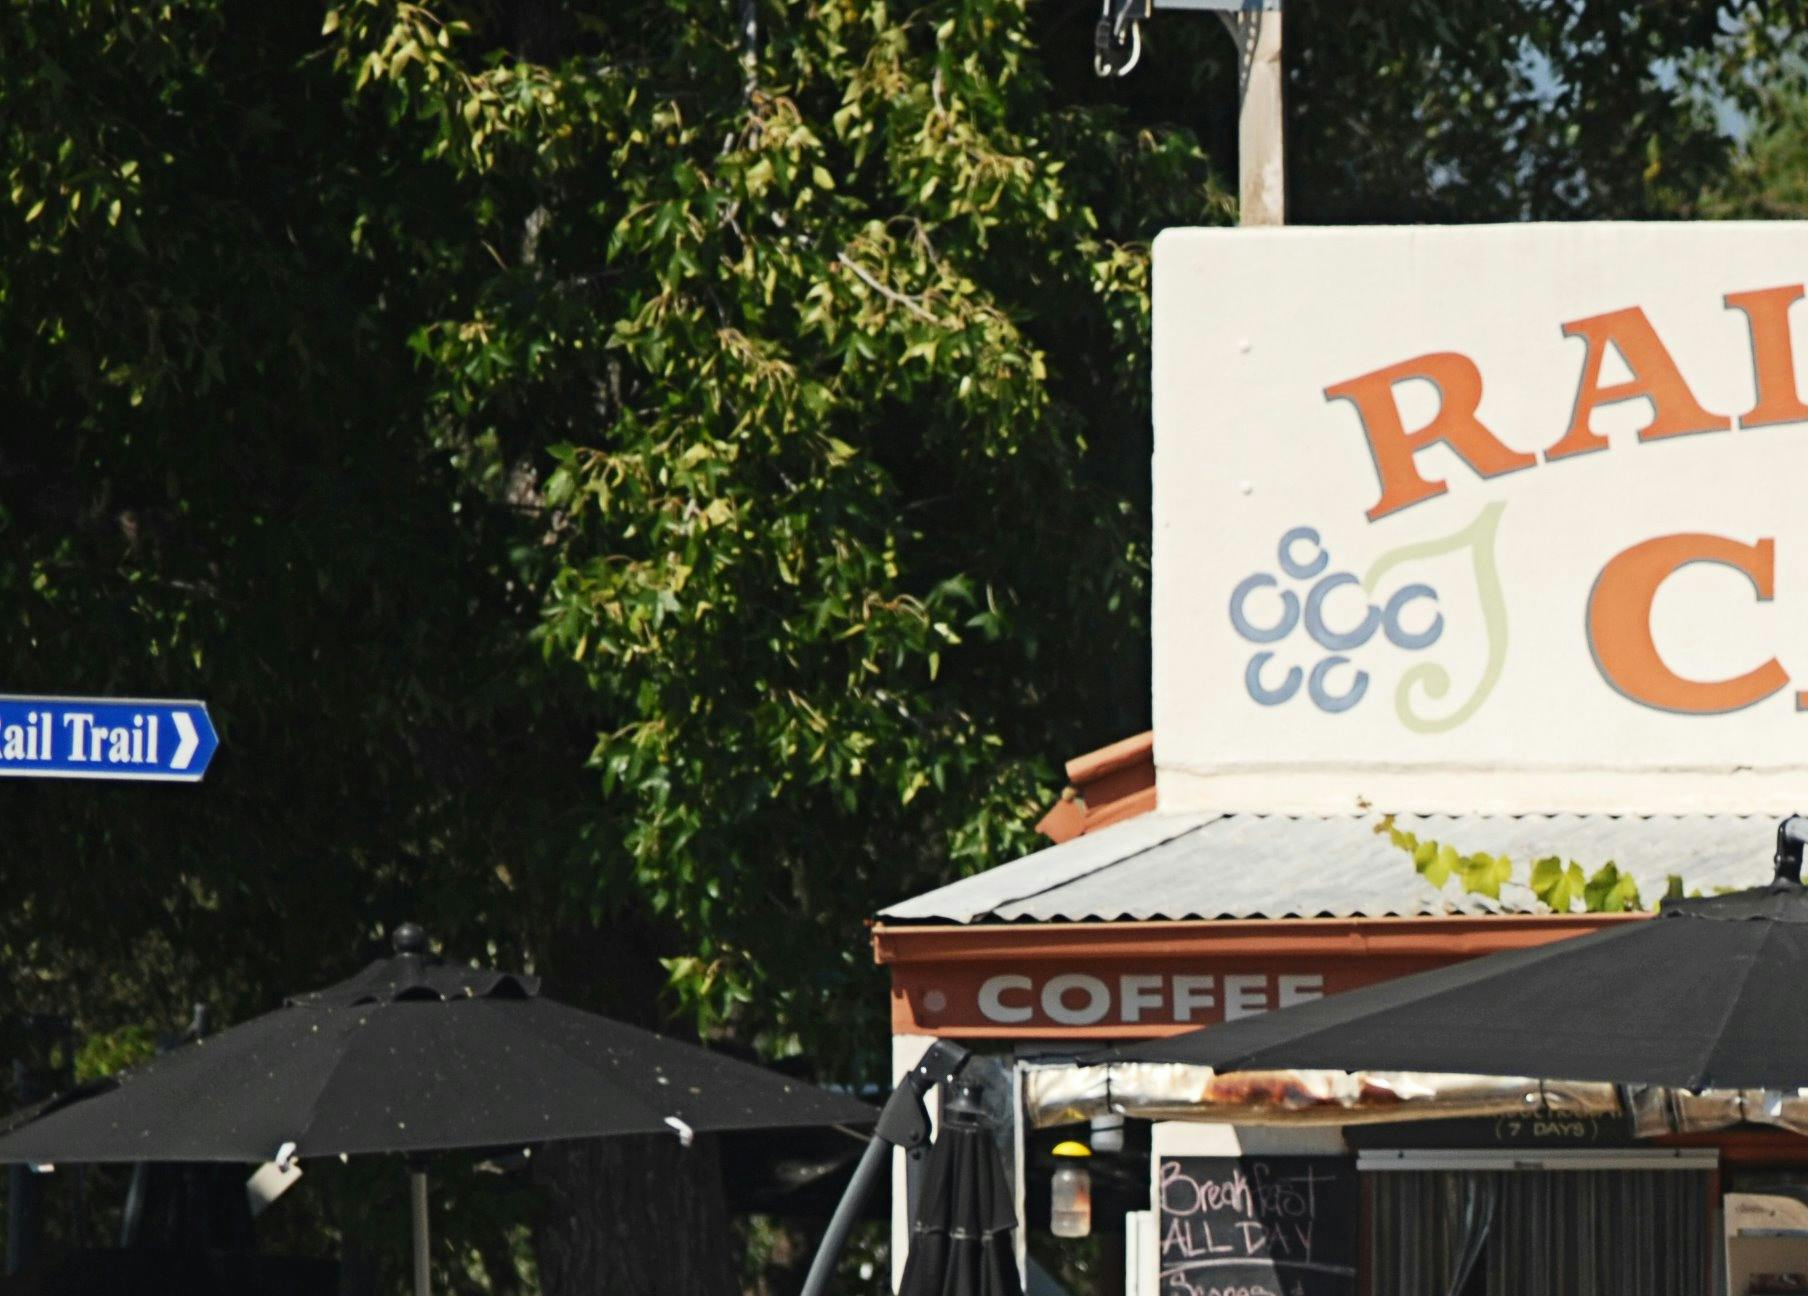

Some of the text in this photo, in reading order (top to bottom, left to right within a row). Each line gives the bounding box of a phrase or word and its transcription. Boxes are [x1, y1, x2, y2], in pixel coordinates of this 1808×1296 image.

[0, 711, 159, 764] ail Trail
[1162, 1217, 1313, 1264] ALL DAY
